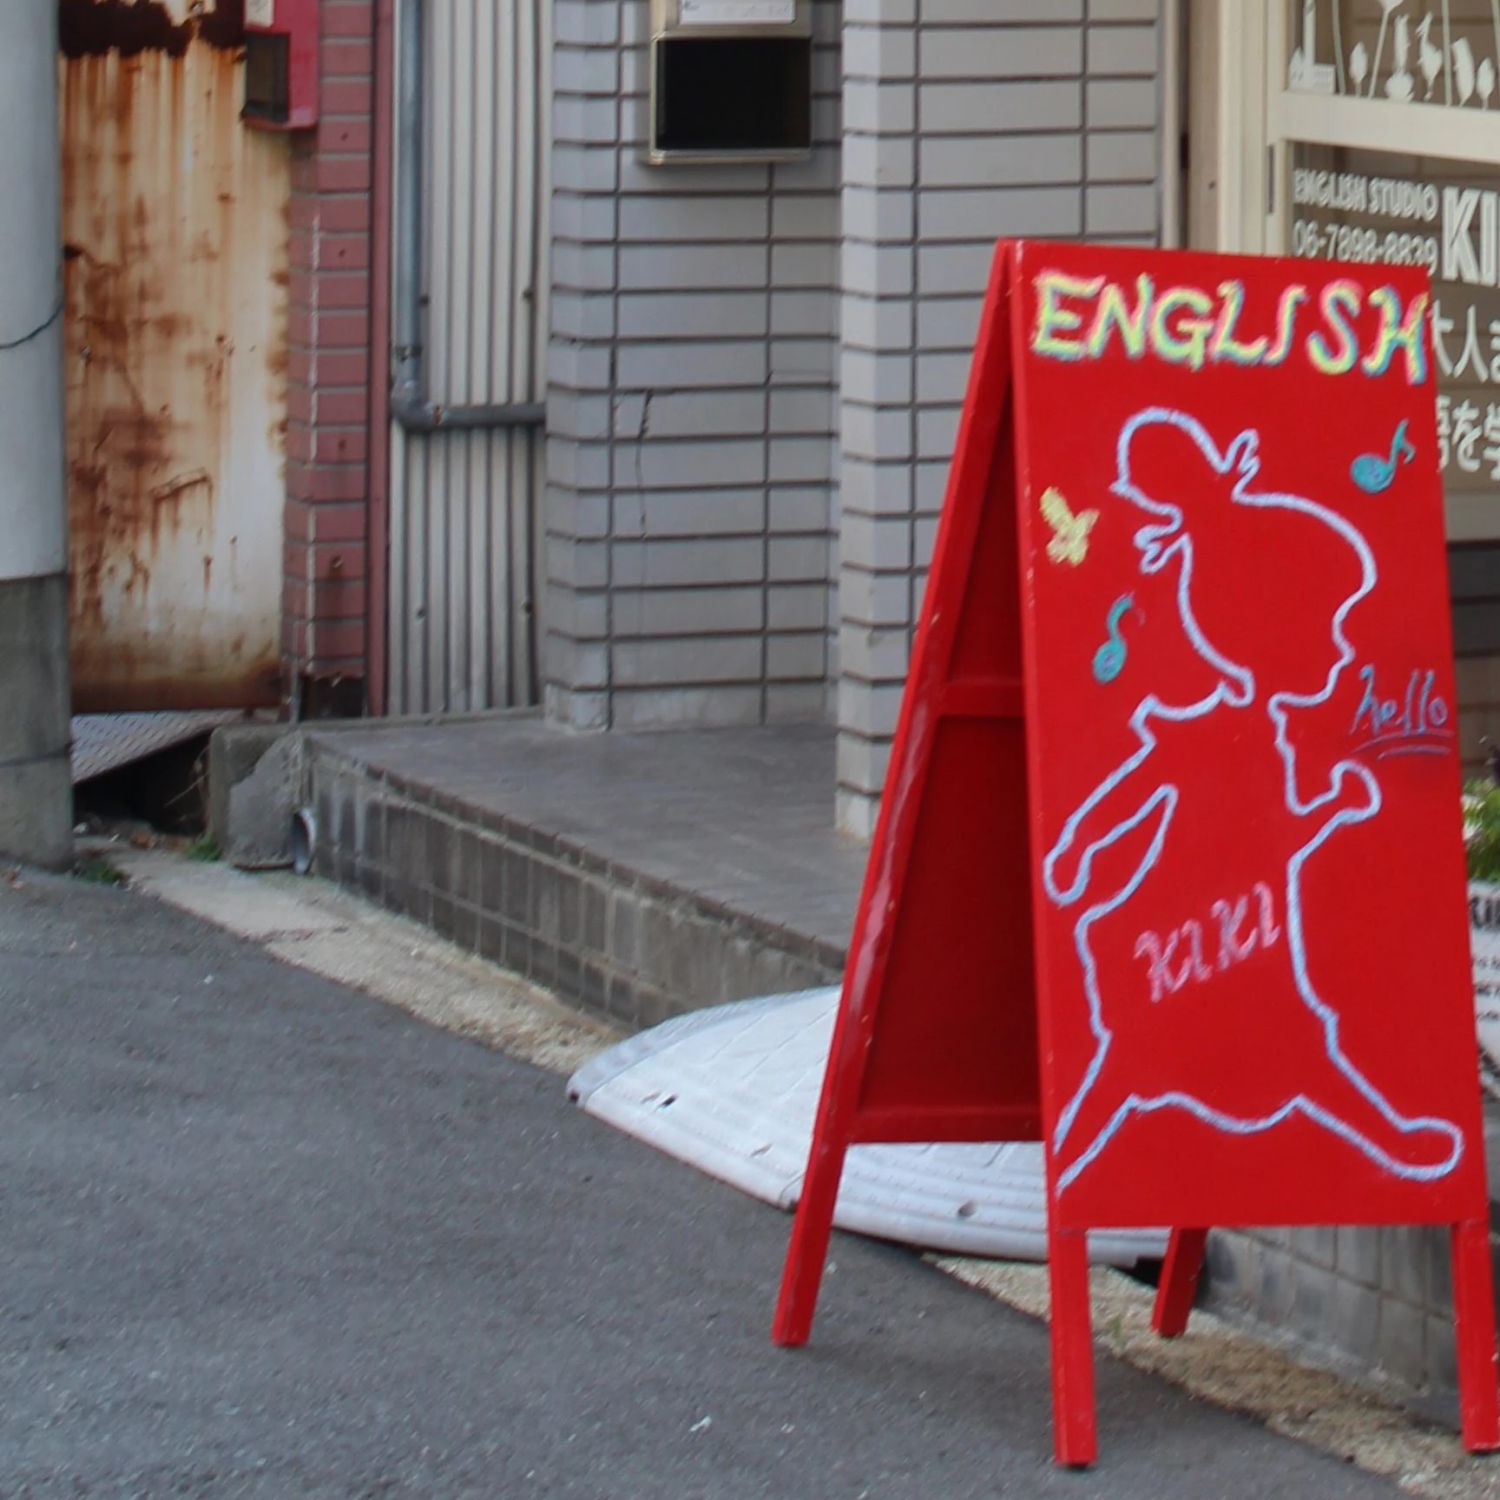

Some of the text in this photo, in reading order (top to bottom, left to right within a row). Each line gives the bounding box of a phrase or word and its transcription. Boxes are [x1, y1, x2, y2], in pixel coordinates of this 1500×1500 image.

[1293, 167, 1439, 222] ENGLISH STUDIO
[1031, 269, 1430, 384] ENGLISH
[1348, 666, 1449, 733] hello
[1133, 881, 1281, 1003] KIKI
